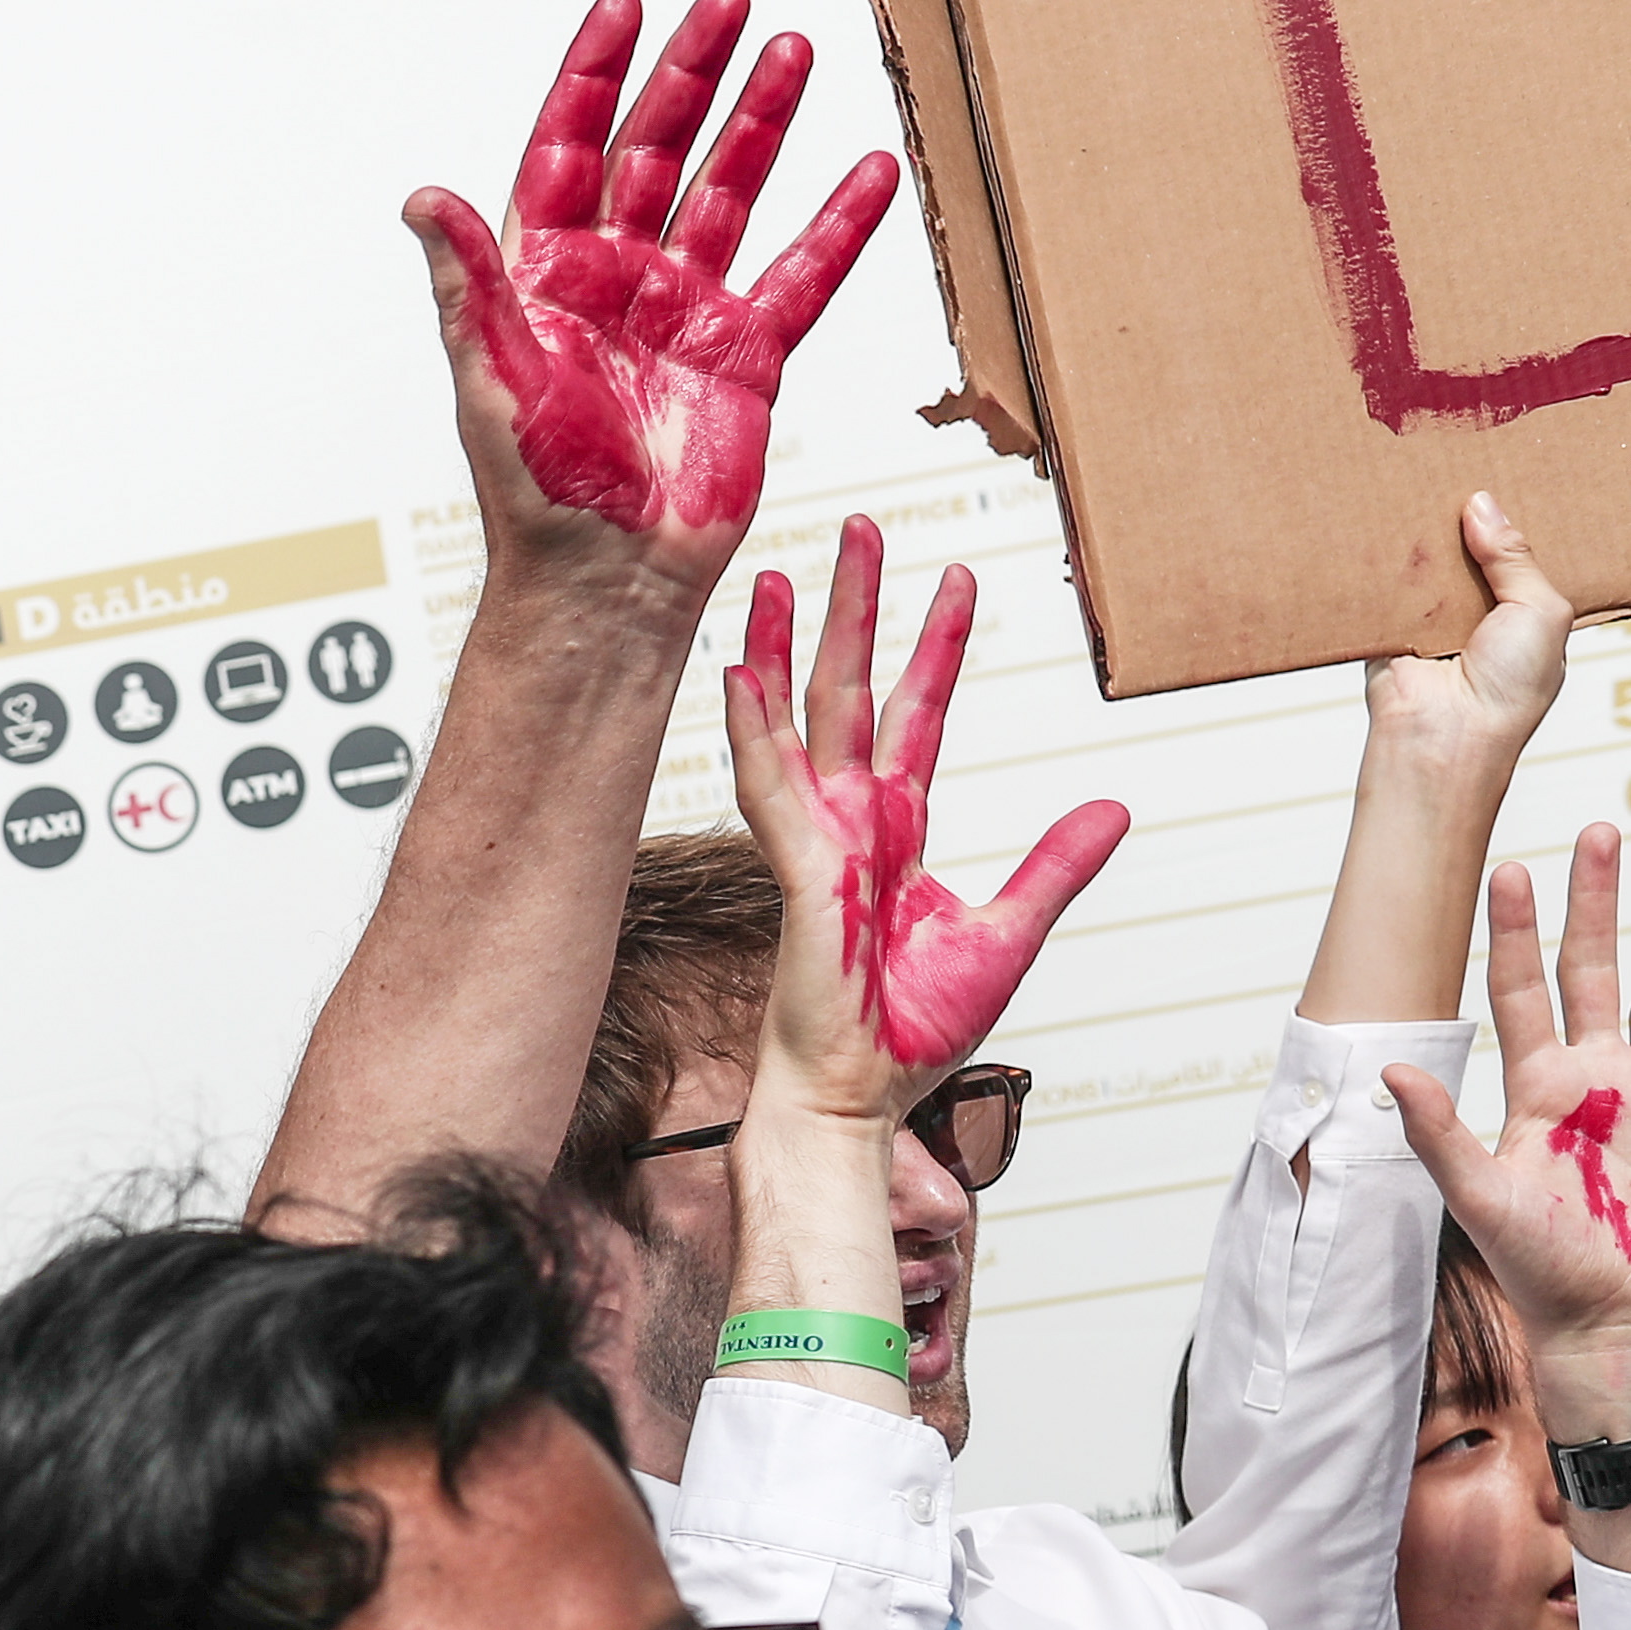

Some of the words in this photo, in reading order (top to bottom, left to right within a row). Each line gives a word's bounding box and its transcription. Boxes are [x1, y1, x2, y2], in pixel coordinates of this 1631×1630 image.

[17, 597, 61, 640] D
[72, 575, 229, 630] منطقة
[225, 769, 297, 807] ATM
[6, 809, 82, 846] TAXI
[720, 1335, 824, 1355] ORIENTAL
